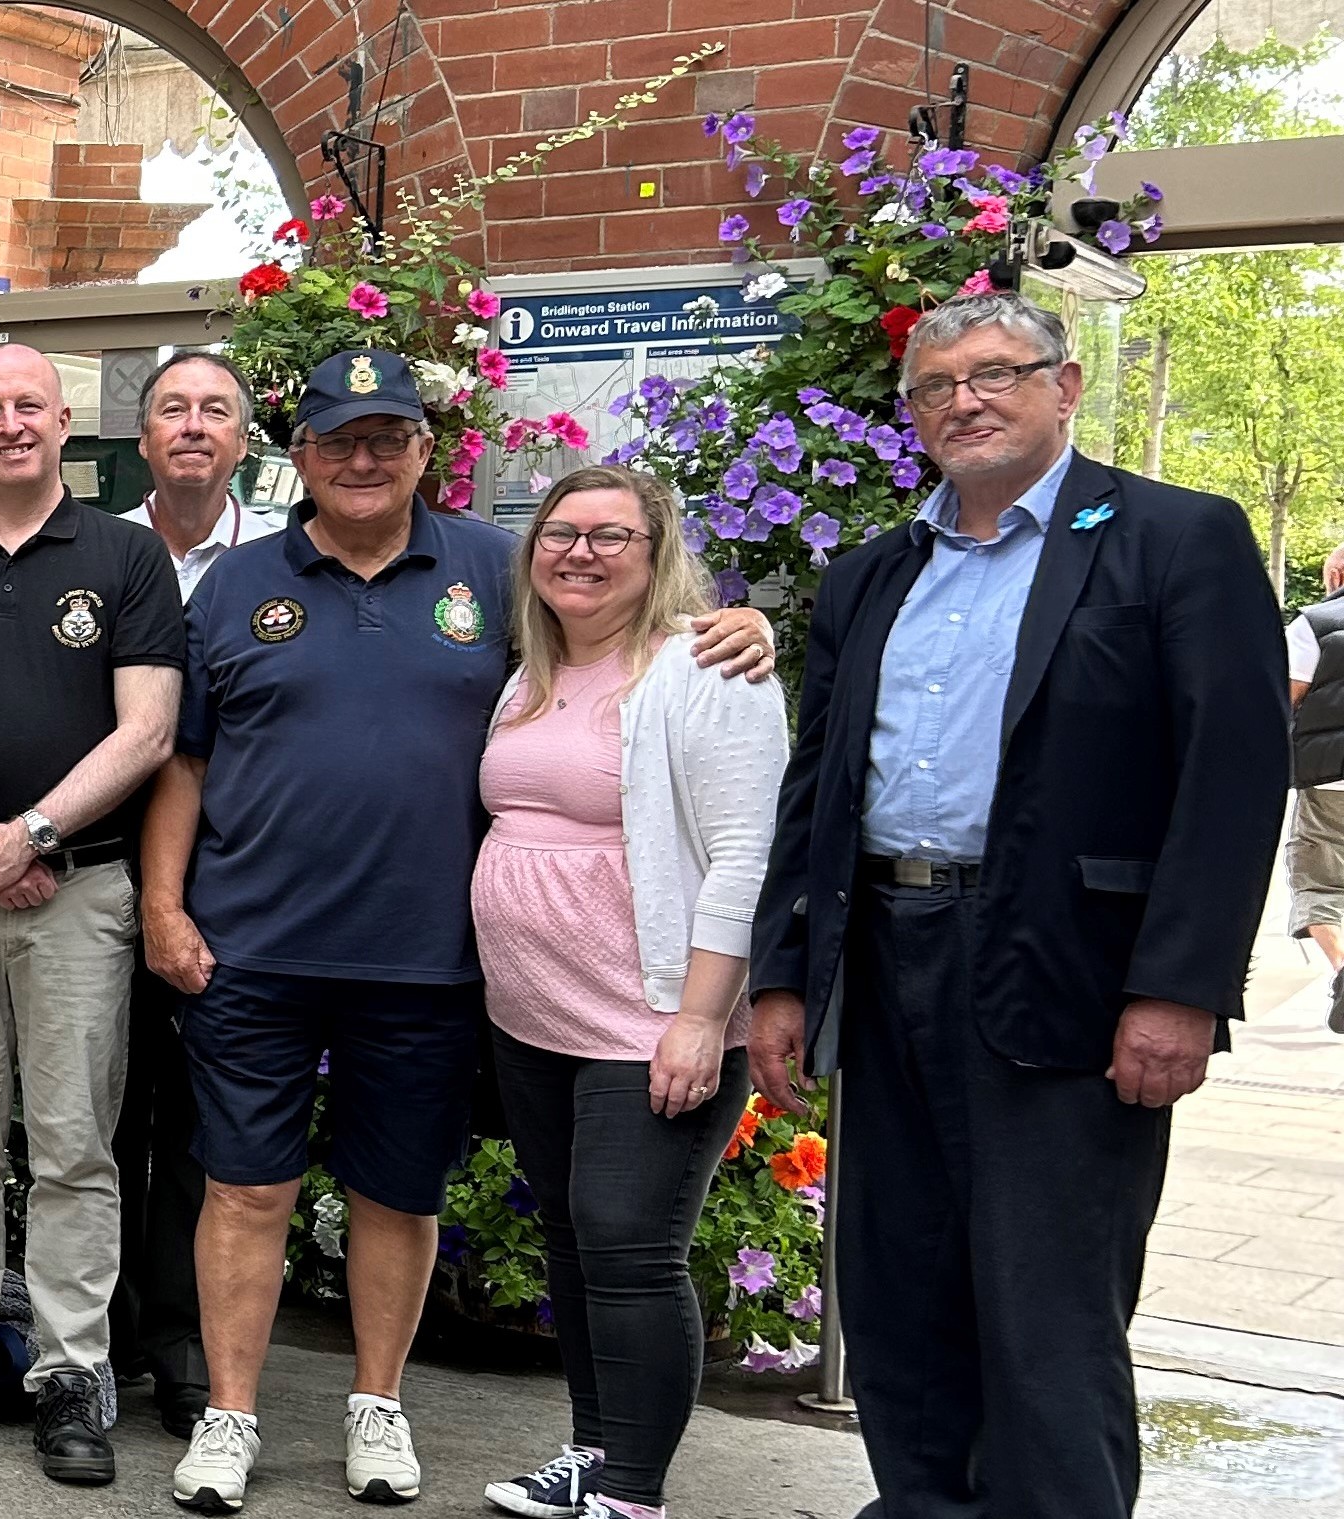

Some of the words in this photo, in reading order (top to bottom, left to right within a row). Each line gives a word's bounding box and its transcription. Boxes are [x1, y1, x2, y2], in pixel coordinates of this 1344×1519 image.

[541, 302, 605, 317] Bridlington
[608, 300, 650, 313] Station
[541, 319, 609, 339] Onward
[614, 316, 666, 335] Travel
